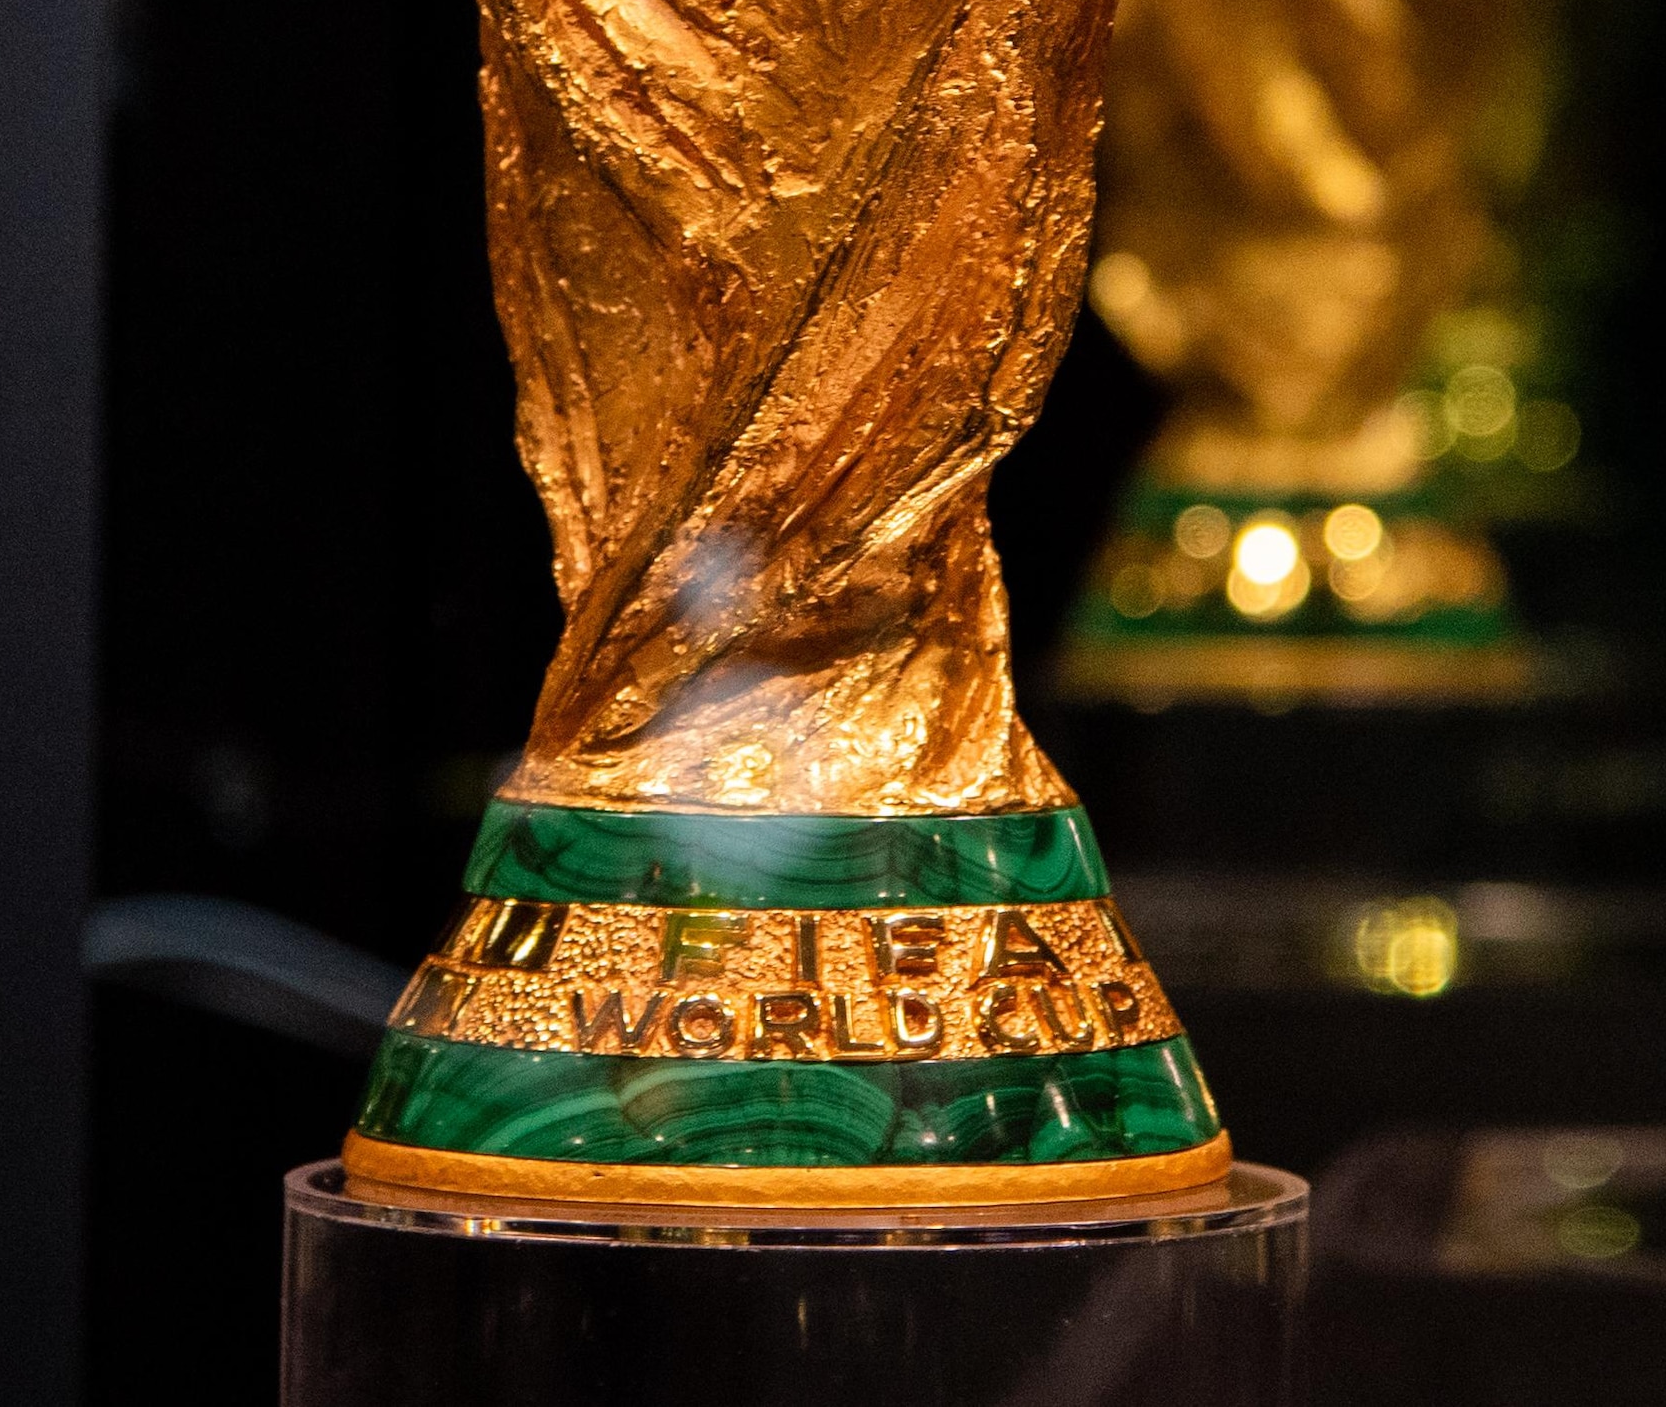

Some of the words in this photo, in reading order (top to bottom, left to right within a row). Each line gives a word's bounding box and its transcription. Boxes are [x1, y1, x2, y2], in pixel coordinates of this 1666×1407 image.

[656, 908, 1070, 982] FIFA
[571, 987, 945, 1060] WORLD
[978, 980, 1139, 1056] CUP
